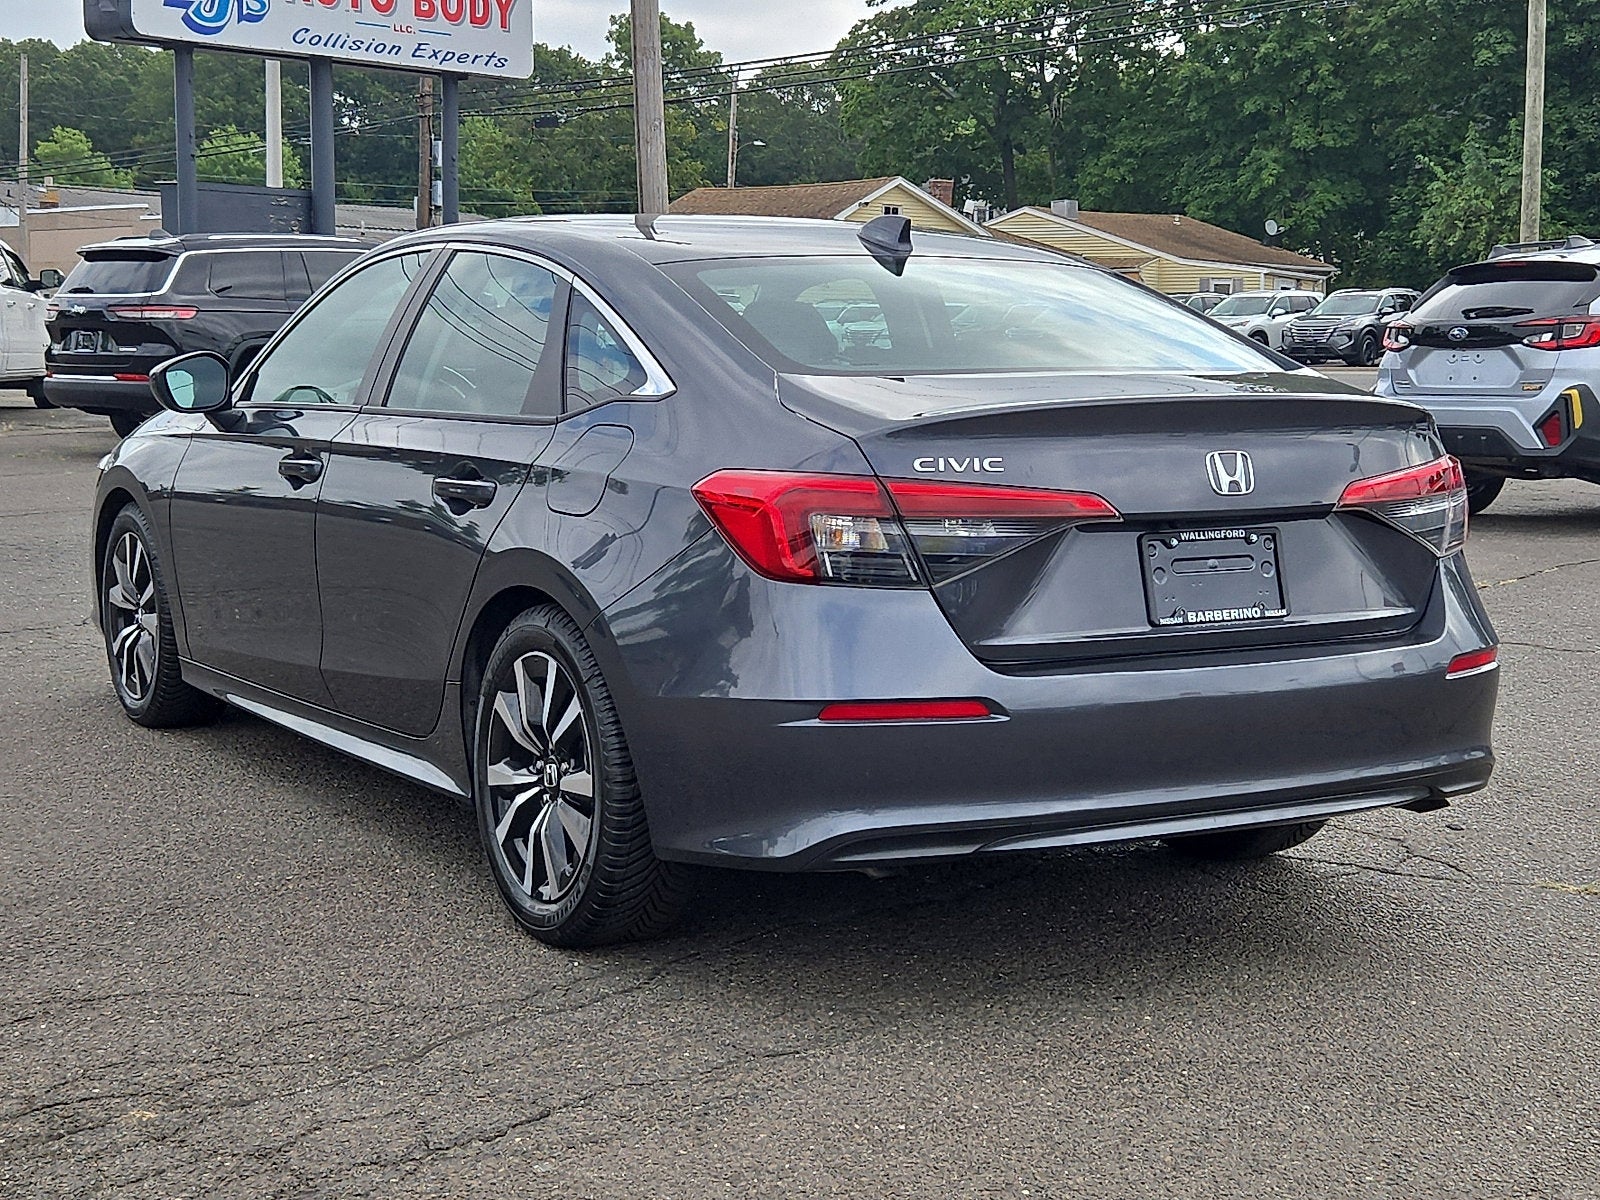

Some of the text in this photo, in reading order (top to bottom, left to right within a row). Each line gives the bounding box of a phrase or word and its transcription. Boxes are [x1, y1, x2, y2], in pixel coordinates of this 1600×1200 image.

[393, 23, 416, 34] LLC.
[292, 27, 509, 69] Collision Experts
[912, 456, 1005, 473] CIVIC
[1180, 529, 1246, 541] WALLINGFORD
[1187, 607, 1261, 623] BARBERINO
